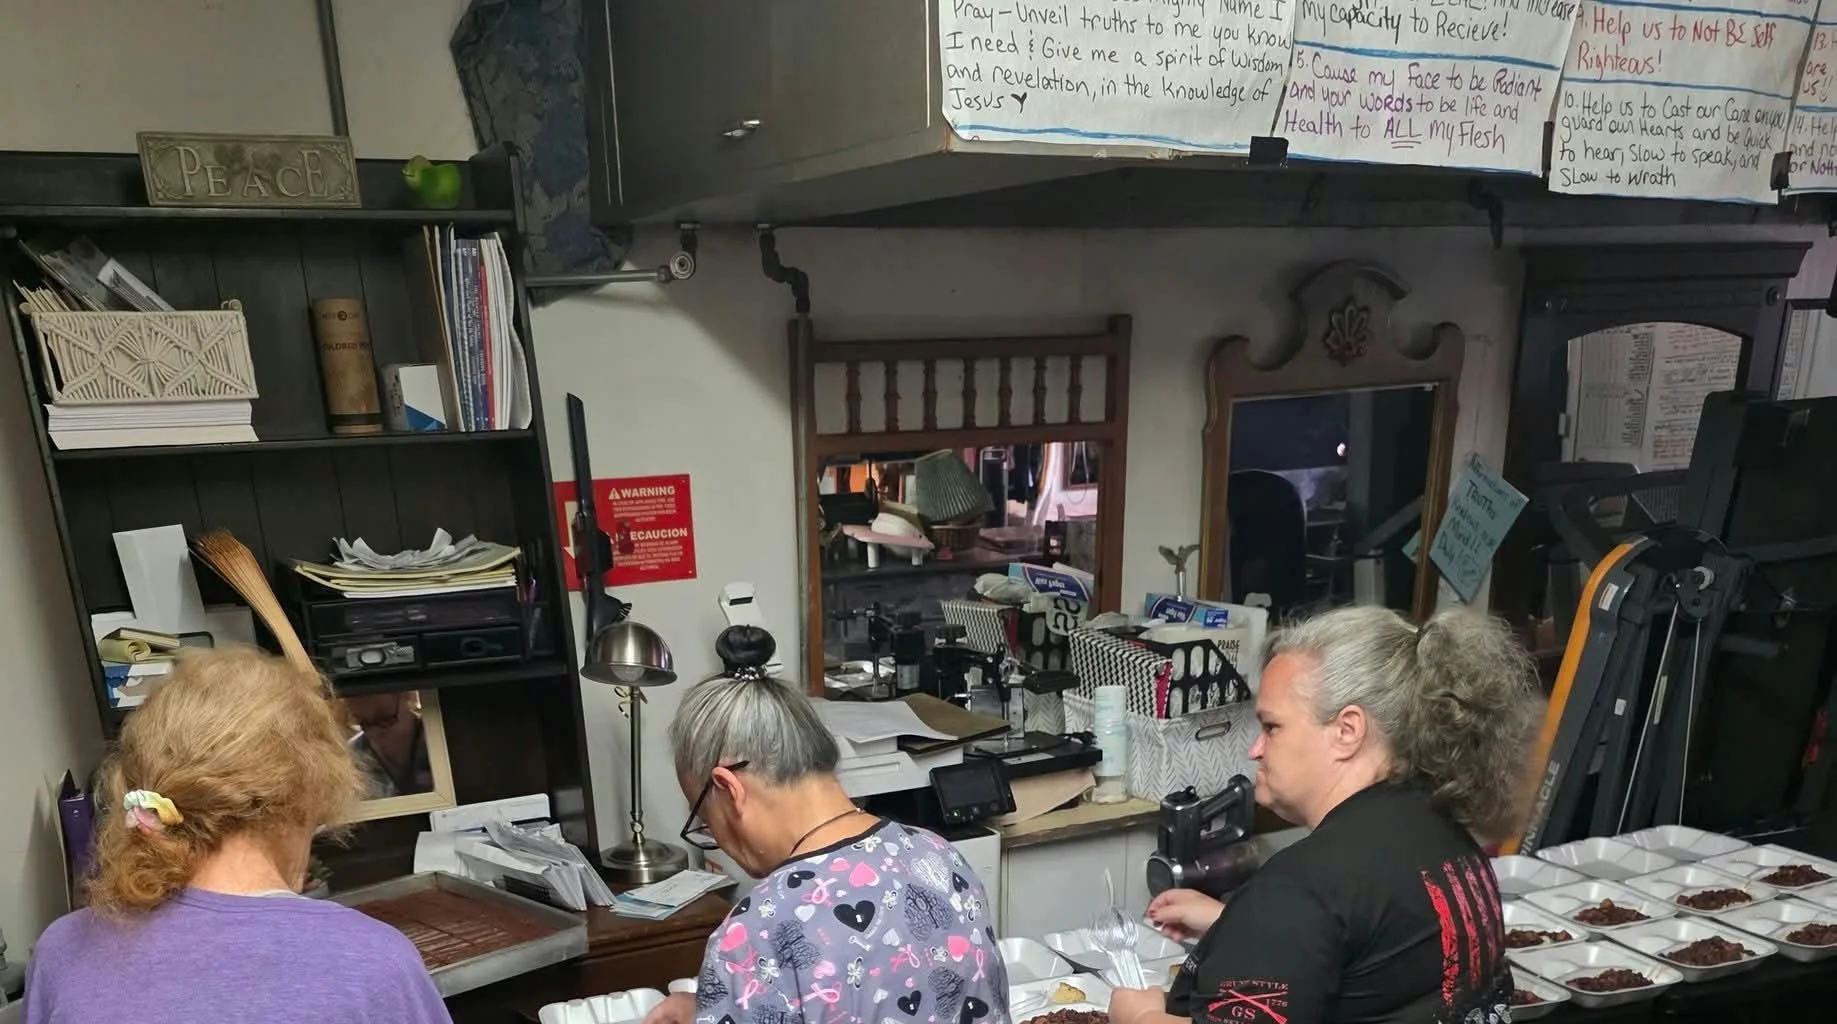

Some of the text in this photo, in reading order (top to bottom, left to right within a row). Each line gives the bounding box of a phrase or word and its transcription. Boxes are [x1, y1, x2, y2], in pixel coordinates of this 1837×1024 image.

[1016, 1, 1069, 27] Unveil
[1080, 6, 1137, 34] truths
[1146, 13, 1164, 35] to
[1174, 21, 1201, 39] me
[1213, 25, 1240, 48] you
[1247, 23, 1292, 49] know
[1409, 7, 1429, 34] to
[1593, 5, 1631, 46] Help
[1642, 20, 1663, 40] us
[1670, 13, 1687, 41] to
[1692, 18, 1720, 43] Not
[945, 31, 964, 49] I
[971, 30, 1019, 54] need
[1042, 36, 1082, 61] Give
[1091, 49, 1120, 63] me
[1134, 51, 1147, 66] a
[1155, 44, 1202, 71] spirit
[1208, 47, 1227, 66] of
[1231, 50, 1283, 77] Wisdom
[946, 62, 982, 82] and
[992, 65, 1097, 103] revelation,
[1101, 75, 1117, 96] in
[1124, 73, 1152, 98] the
[1251, 77, 1272, 101] of
[1312, 52, 1358, 83] Cause
[1369, 70, 1395, 97] my
[1446, 63, 1463, 90] to
[1469, 65, 1486, 90] be
[948, 87, 1004, 111] Jesus
[1322, 86, 1351, 113] your
[1416, 93, 1434, 113] to
[1440, 96, 1456, 112] be
[1465, 95, 1487, 117] life
[1493, 101, 1519, 125] and
[1582, 91, 1613, 120] Help
[1620, 100, 1634, 116] us
[1640, 91, 1656, 119] to
[1662, 95, 1691, 119] Cast
[1696, 104, 1721, 119] our
[1284, 109, 1343, 139] Health
[1350, 113, 1371, 139] to
[1384, 115, 1422, 139] ALL
[1458, 120, 1505, 155] Flesh
[1559, 115, 1603, 143] guard
[1692, 125, 1720, 141] and
[1727, 123, 1740, 145] be
[1559, 140, 1576, 162] to
[1671, 140, 1687, 164] to
[1739, 151, 1761, 171] and
[175, 145, 329, 198] PEACE
[1605, 168, 1621, 184] to
[620, 485, 676, 498] WARNING
[617, 527, 688, 541] ECAUCION
[1231, 1005, 1257, 1020] GS
